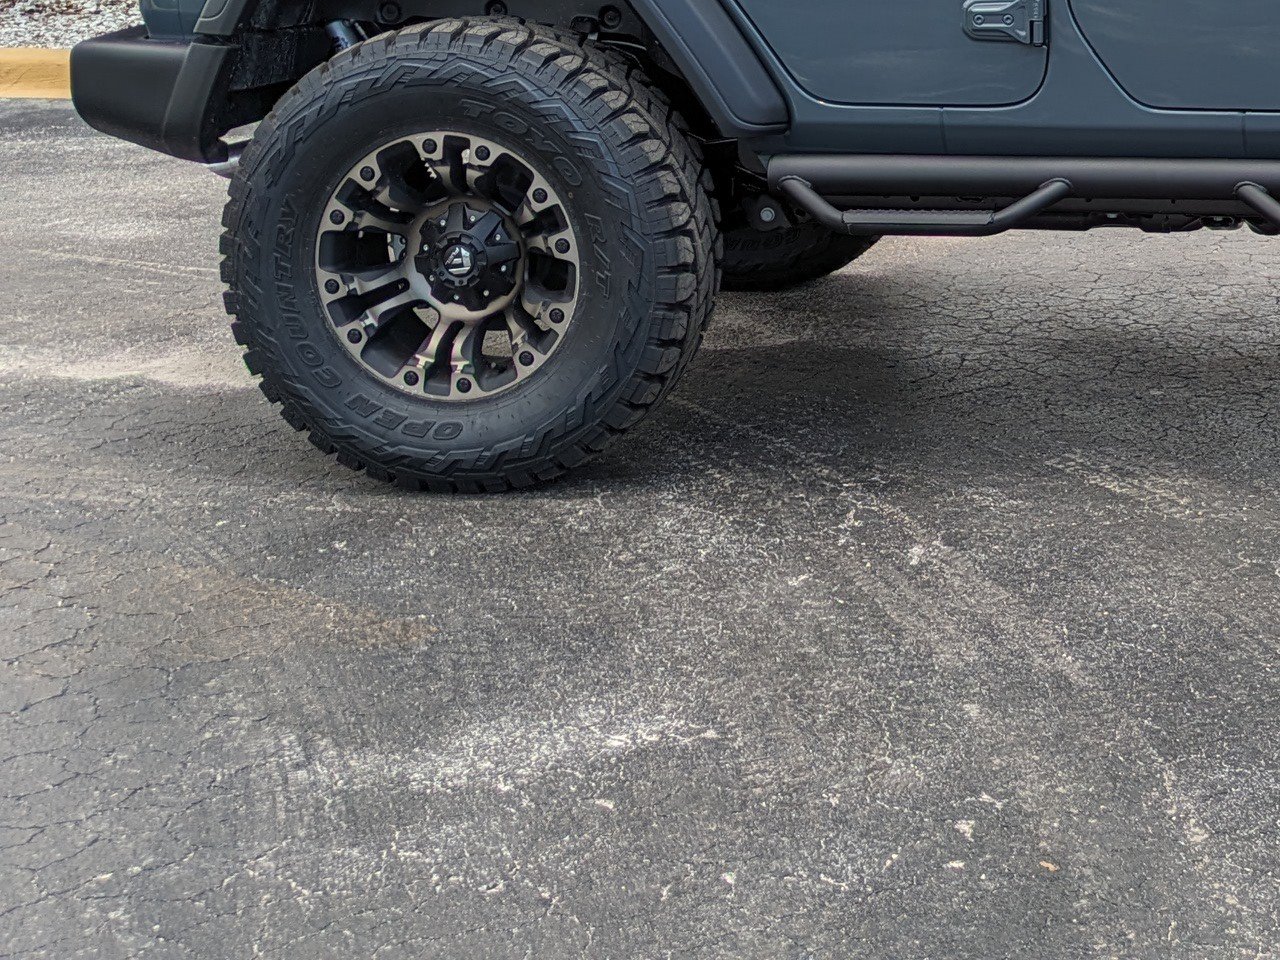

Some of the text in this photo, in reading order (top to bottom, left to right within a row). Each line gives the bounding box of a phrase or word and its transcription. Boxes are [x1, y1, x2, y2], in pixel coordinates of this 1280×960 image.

[458, 98, 583, 186] TOYO
[272, 193, 465, 441] OPEN COUNTRY
